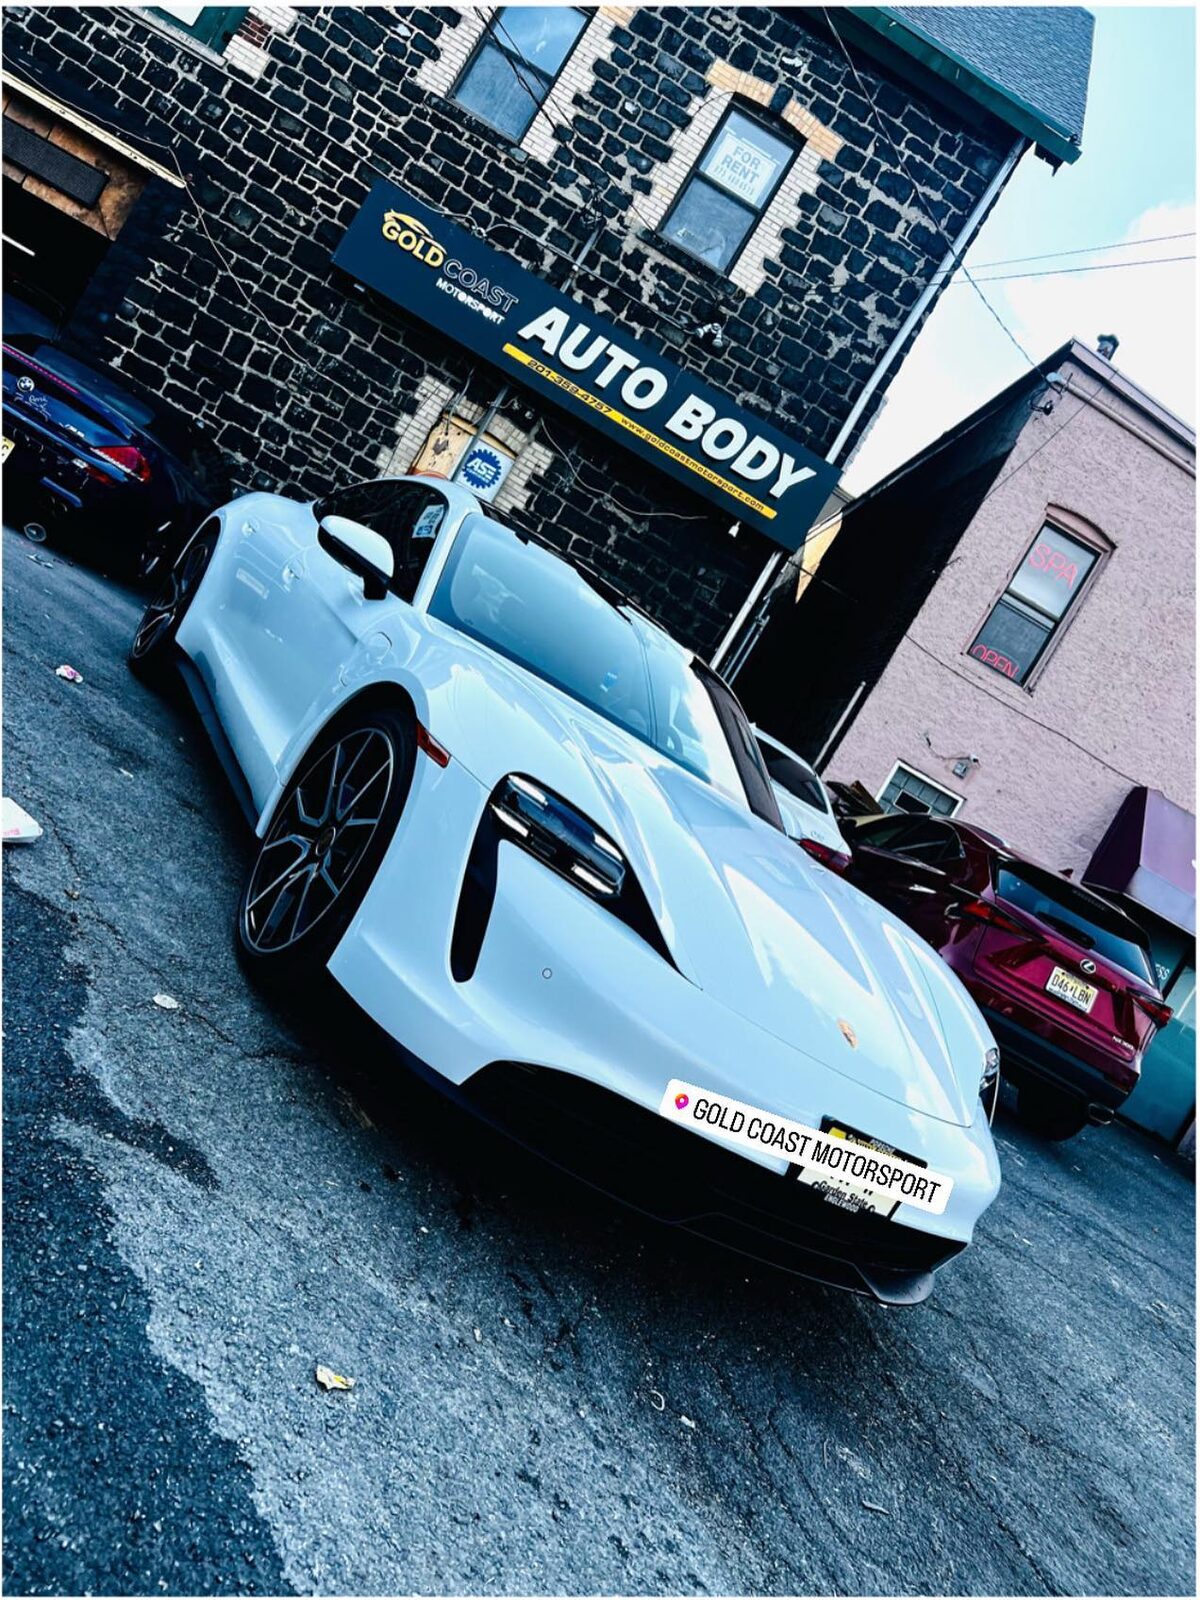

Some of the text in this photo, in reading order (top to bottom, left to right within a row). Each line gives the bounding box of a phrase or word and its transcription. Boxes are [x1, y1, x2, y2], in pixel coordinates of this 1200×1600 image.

[721, 154, 760, 184] RENT
[732, 145, 761, 171] FOR
[382, 219, 520, 314] GOLD COAST
[435, 276, 506, 325] MOTORSPORT
[516, 306, 817, 499] AUTO BODY
[466, 457, 498, 482] ASE
[1029, 544, 1078, 590] SPA
[972, 644, 1019, 678] OPEN
